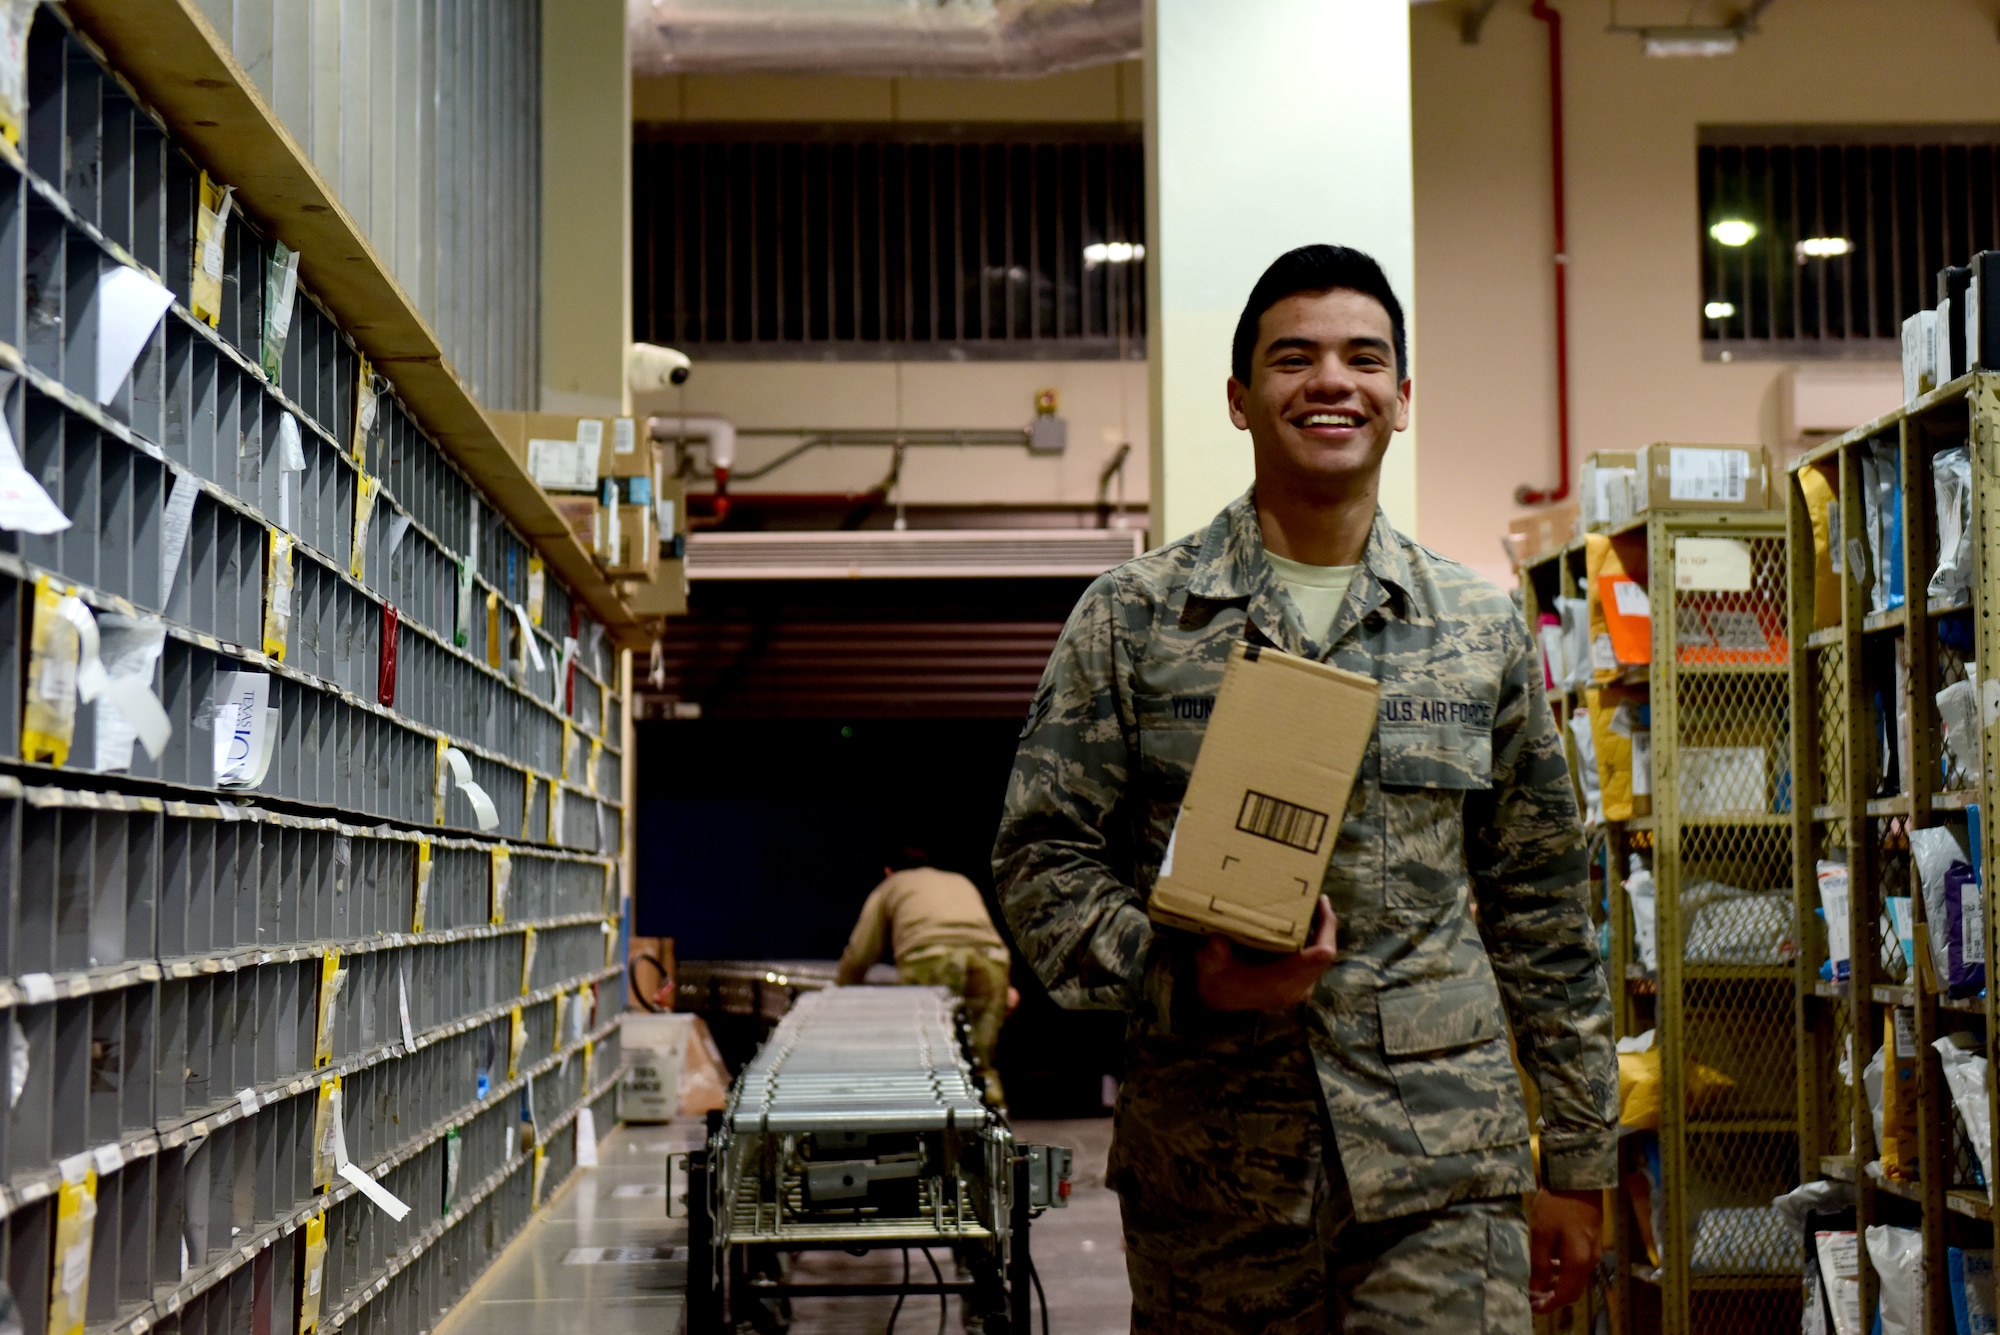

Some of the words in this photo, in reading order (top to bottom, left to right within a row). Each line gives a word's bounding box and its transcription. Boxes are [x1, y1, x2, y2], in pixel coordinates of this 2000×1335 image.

[243, 690, 256, 727] TEXAS
[1386, 700, 1416, 721] U.S.
[1421, 701, 1447, 722] AIR
[1450, 702, 1491, 726] FORCE
